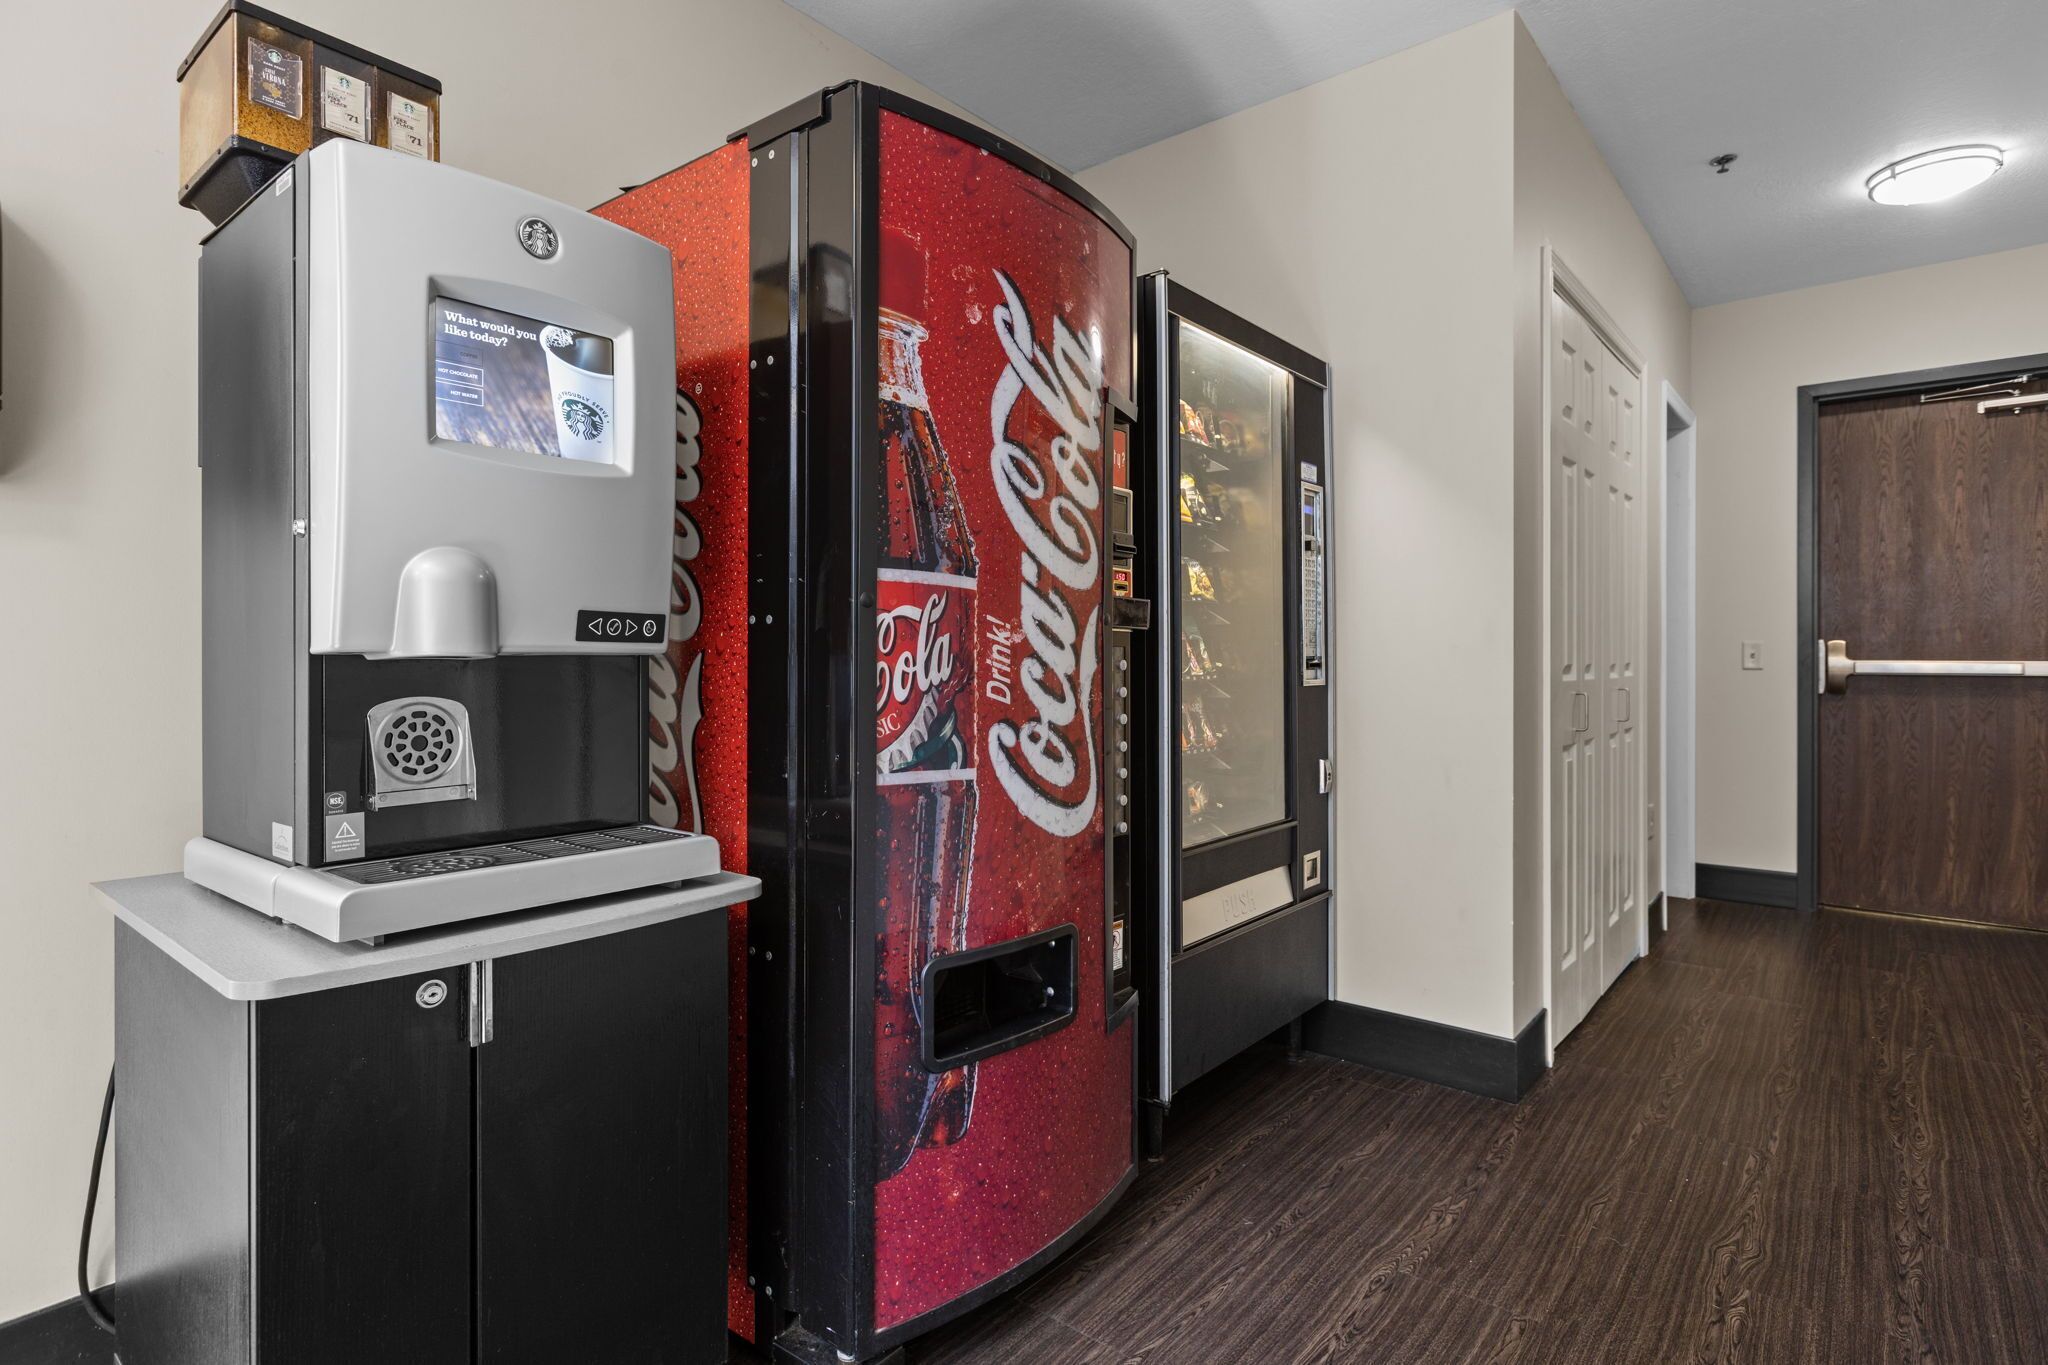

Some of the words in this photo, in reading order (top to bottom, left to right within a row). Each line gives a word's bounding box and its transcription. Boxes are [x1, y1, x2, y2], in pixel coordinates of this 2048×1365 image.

[262, 71, 287, 87] VERONA
[393, 115, 408, 125] PIKE
[395, 120, 415, 131] PLACE
[444, 310, 479, 327] What
[480, 320, 516, 336] would
[516, 329, 537, 341] you
[444, 323, 468, 338] like
[469, 330, 509, 348] today?
[449, 369, 479, 380] CHOCOLATE
[562, 391, 590, 401] PROUDLY
[591, 401, 609, 418] SERVE
[986, 614, 1011, 705] Drink!
